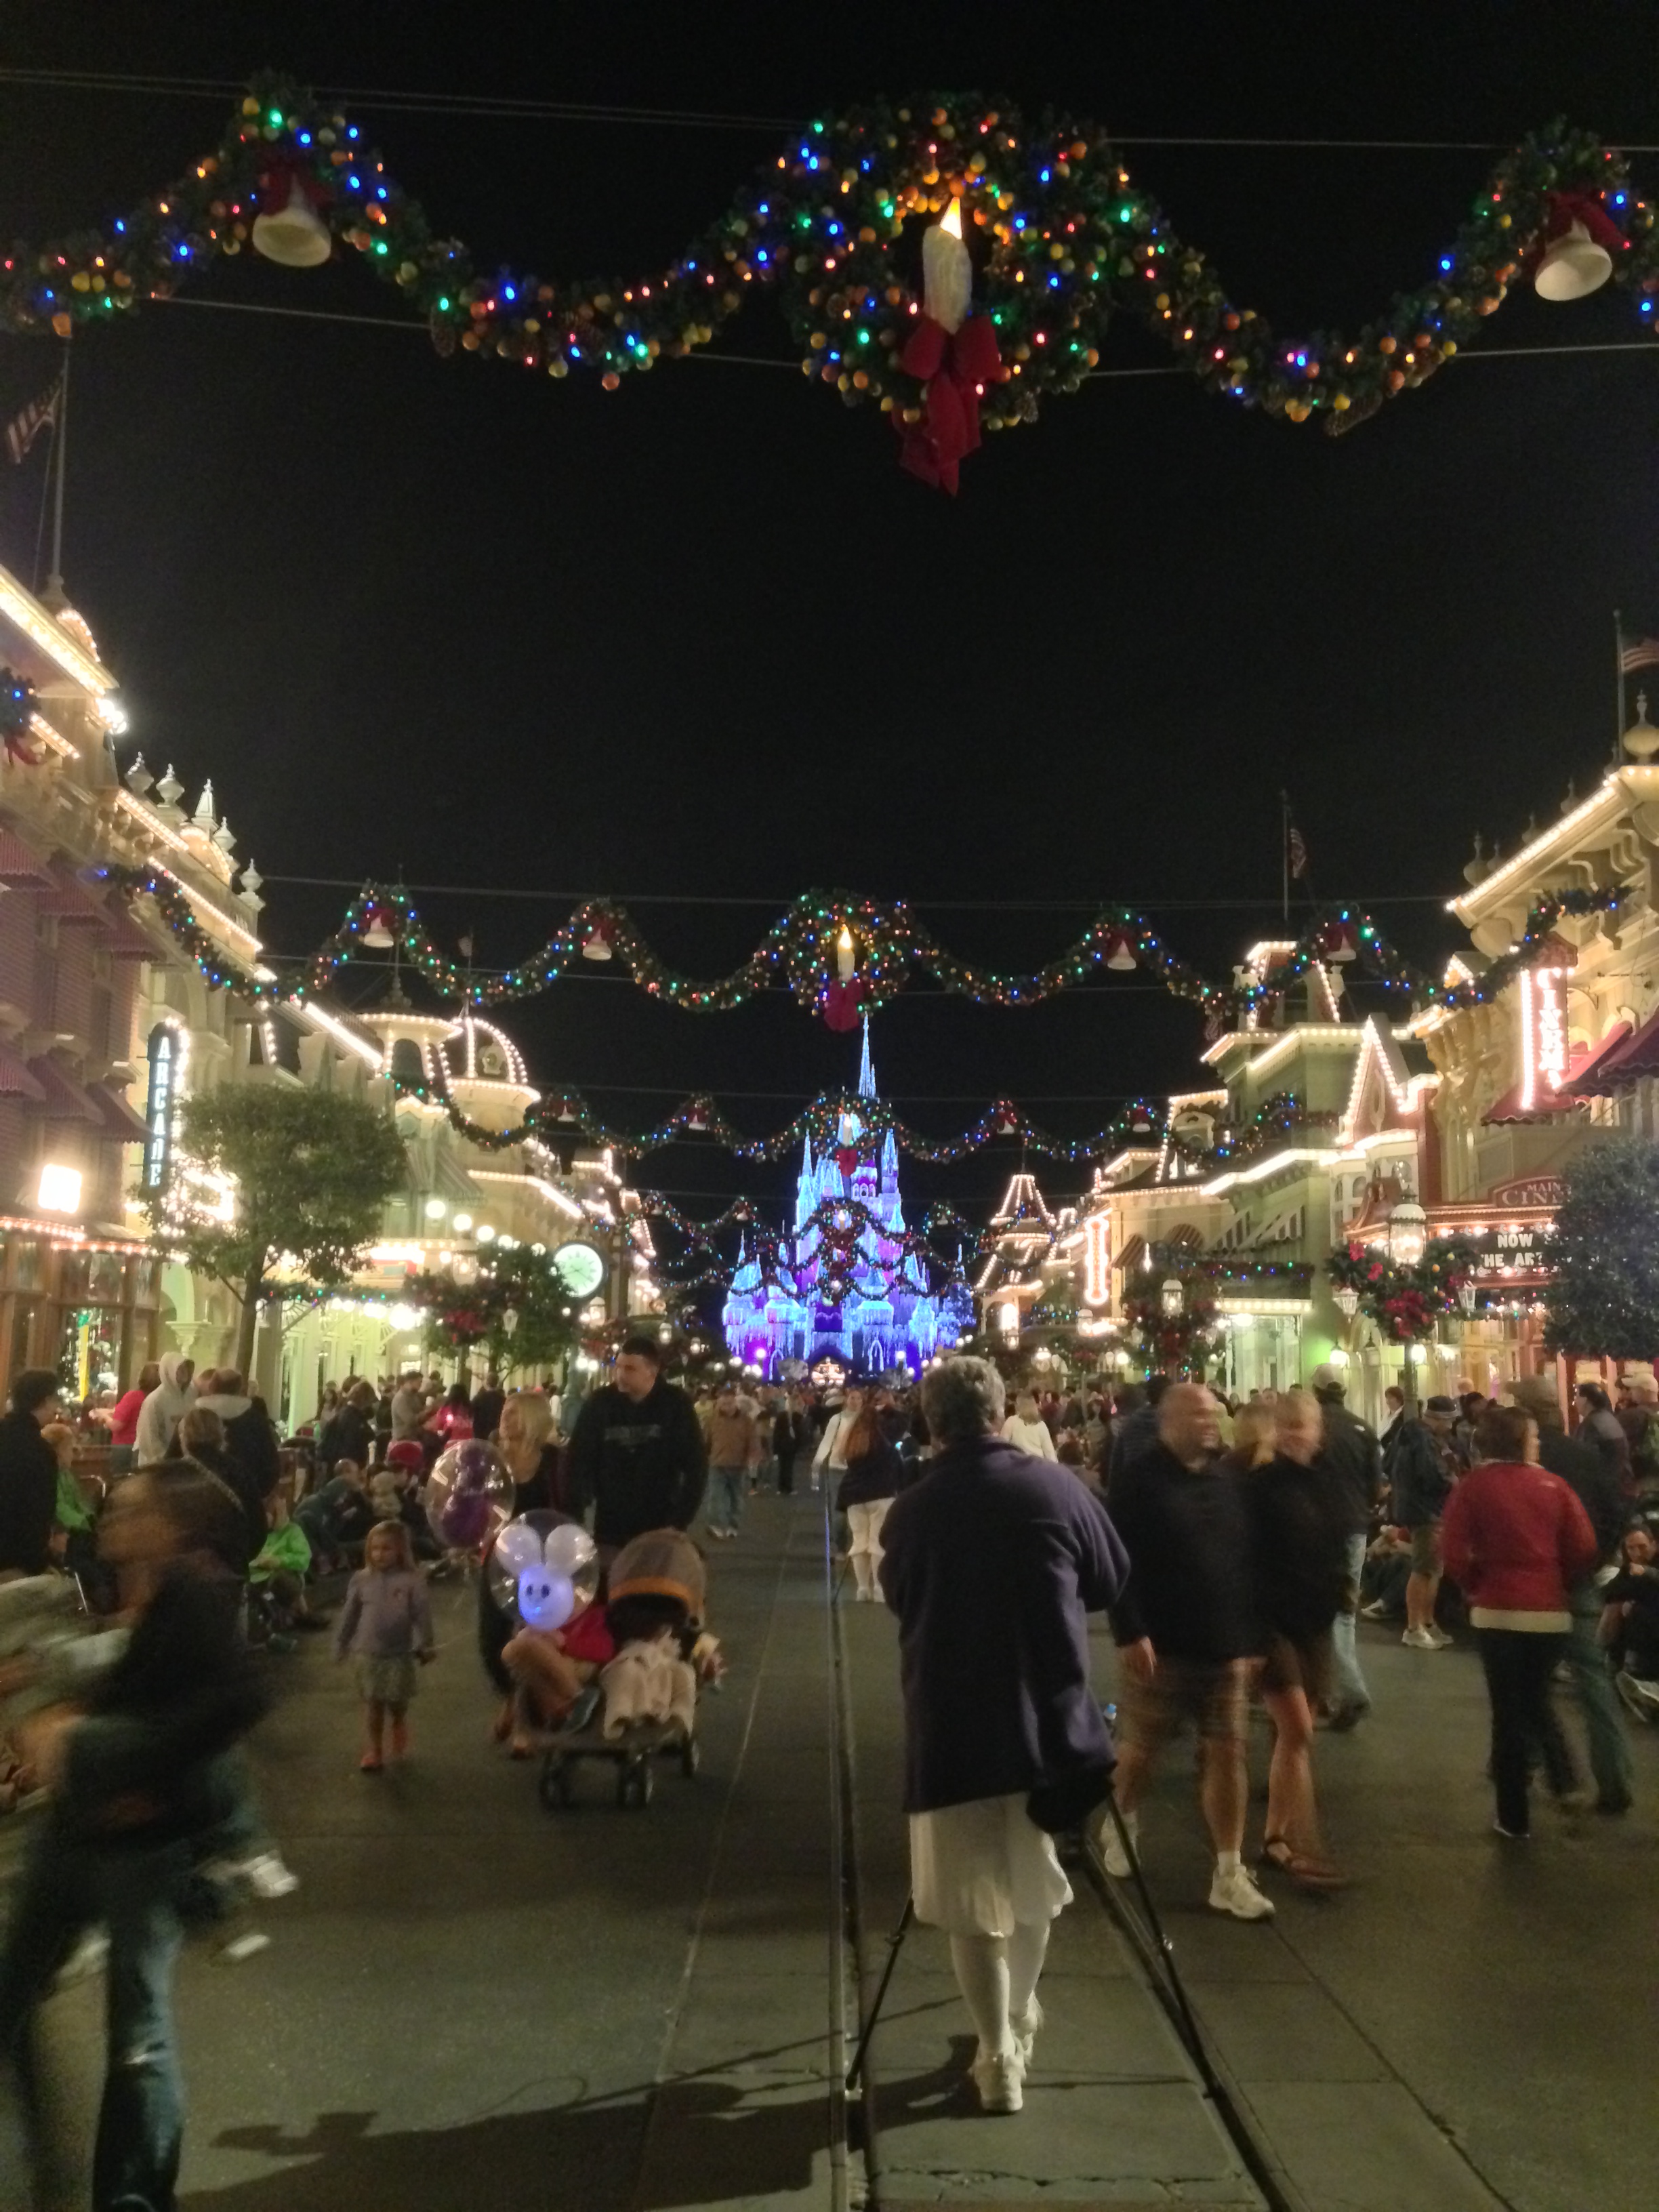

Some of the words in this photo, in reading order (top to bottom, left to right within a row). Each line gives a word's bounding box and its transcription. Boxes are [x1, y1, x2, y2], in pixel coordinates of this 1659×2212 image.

[149, 1036, 171, 1187] ARCADE
[1527, 1182, 1561, 1191] MAIN
[1502, 1190, 1564, 1206] CINE
[1497, 1233, 1533, 1248] NOW
[1481, 1253, 1504, 1268] HE
